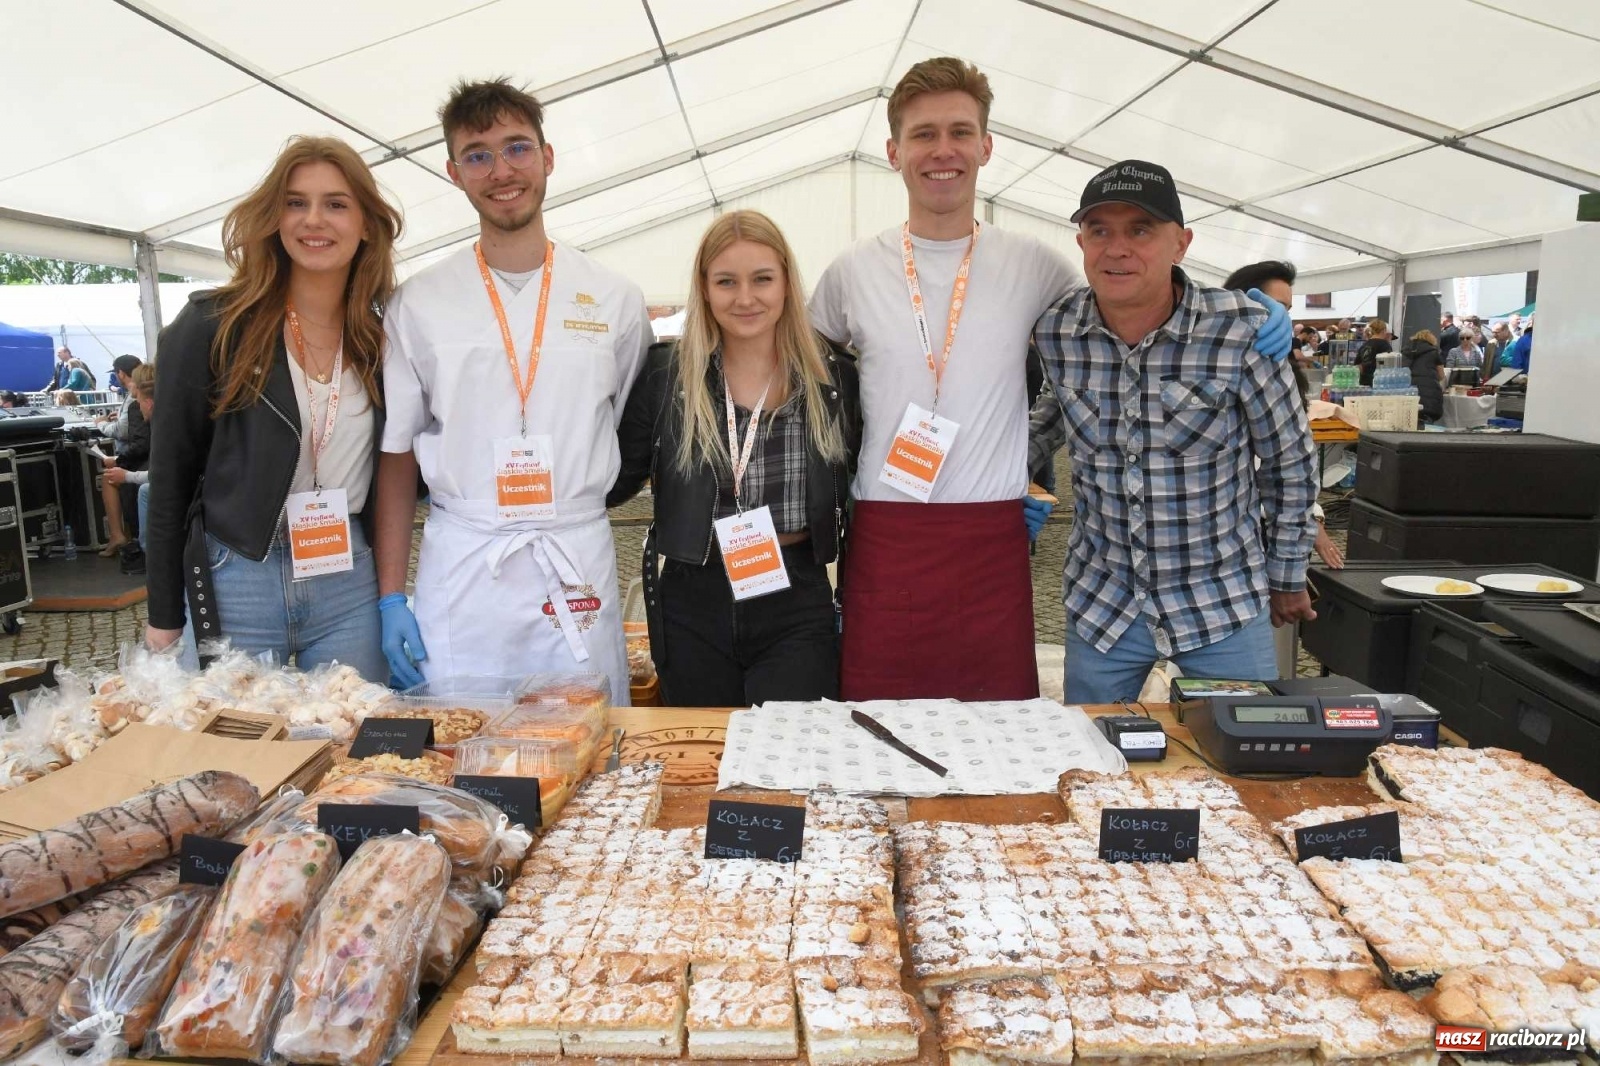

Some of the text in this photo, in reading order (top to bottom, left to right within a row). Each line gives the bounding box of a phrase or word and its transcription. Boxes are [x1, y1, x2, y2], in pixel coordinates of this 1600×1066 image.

[1102, 180, 1142, 193] Poland
[896, 447, 933, 470] Uczestnik
[502, 483, 546, 493] Uczestnik
[299, 534, 342, 547] Uczestnik
[731, 552, 773, 568] Uczestnik
[716, 809, 784, 830] KOŁACZ
[1108, 815, 1169, 832] KOŁACZ
[737, 830, 751, 841] Z
[1303, 828, 1368, 846] KOŁACZ
[1134, 838, 1147, 850] Z
[1330, 846, 1345, 857] Z
